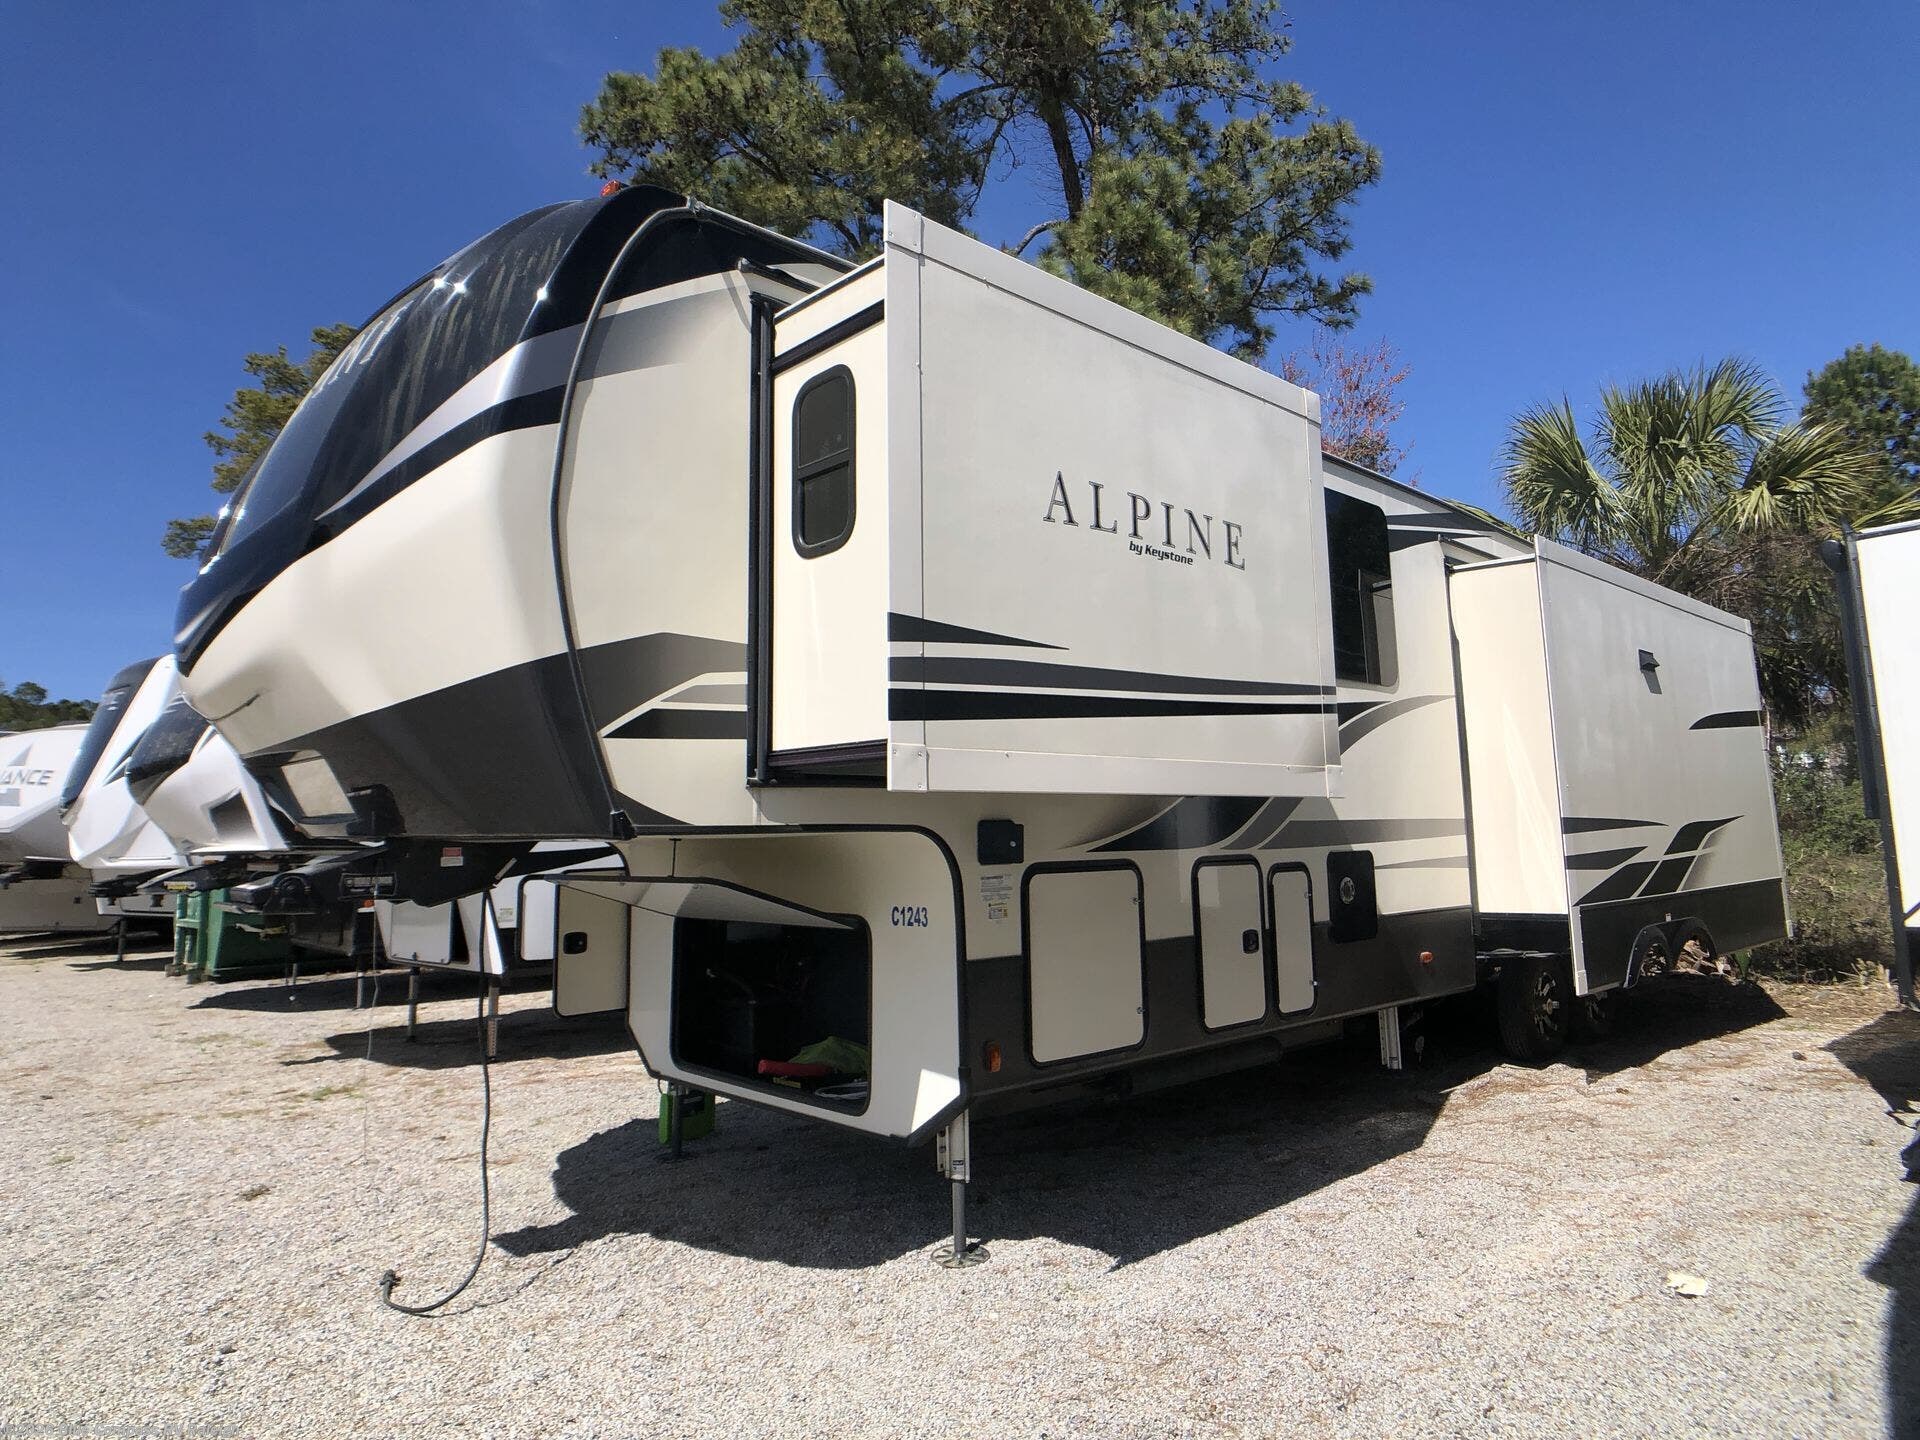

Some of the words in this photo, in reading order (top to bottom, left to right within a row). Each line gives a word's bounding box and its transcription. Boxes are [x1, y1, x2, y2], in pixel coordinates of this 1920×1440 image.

[1043, 470, 1246, 571] ALPINE
[1129, 541, 1143, 556] by
[1145, 544, 1194, 566] Keystone
[891, 906, 928, 927] C1243
